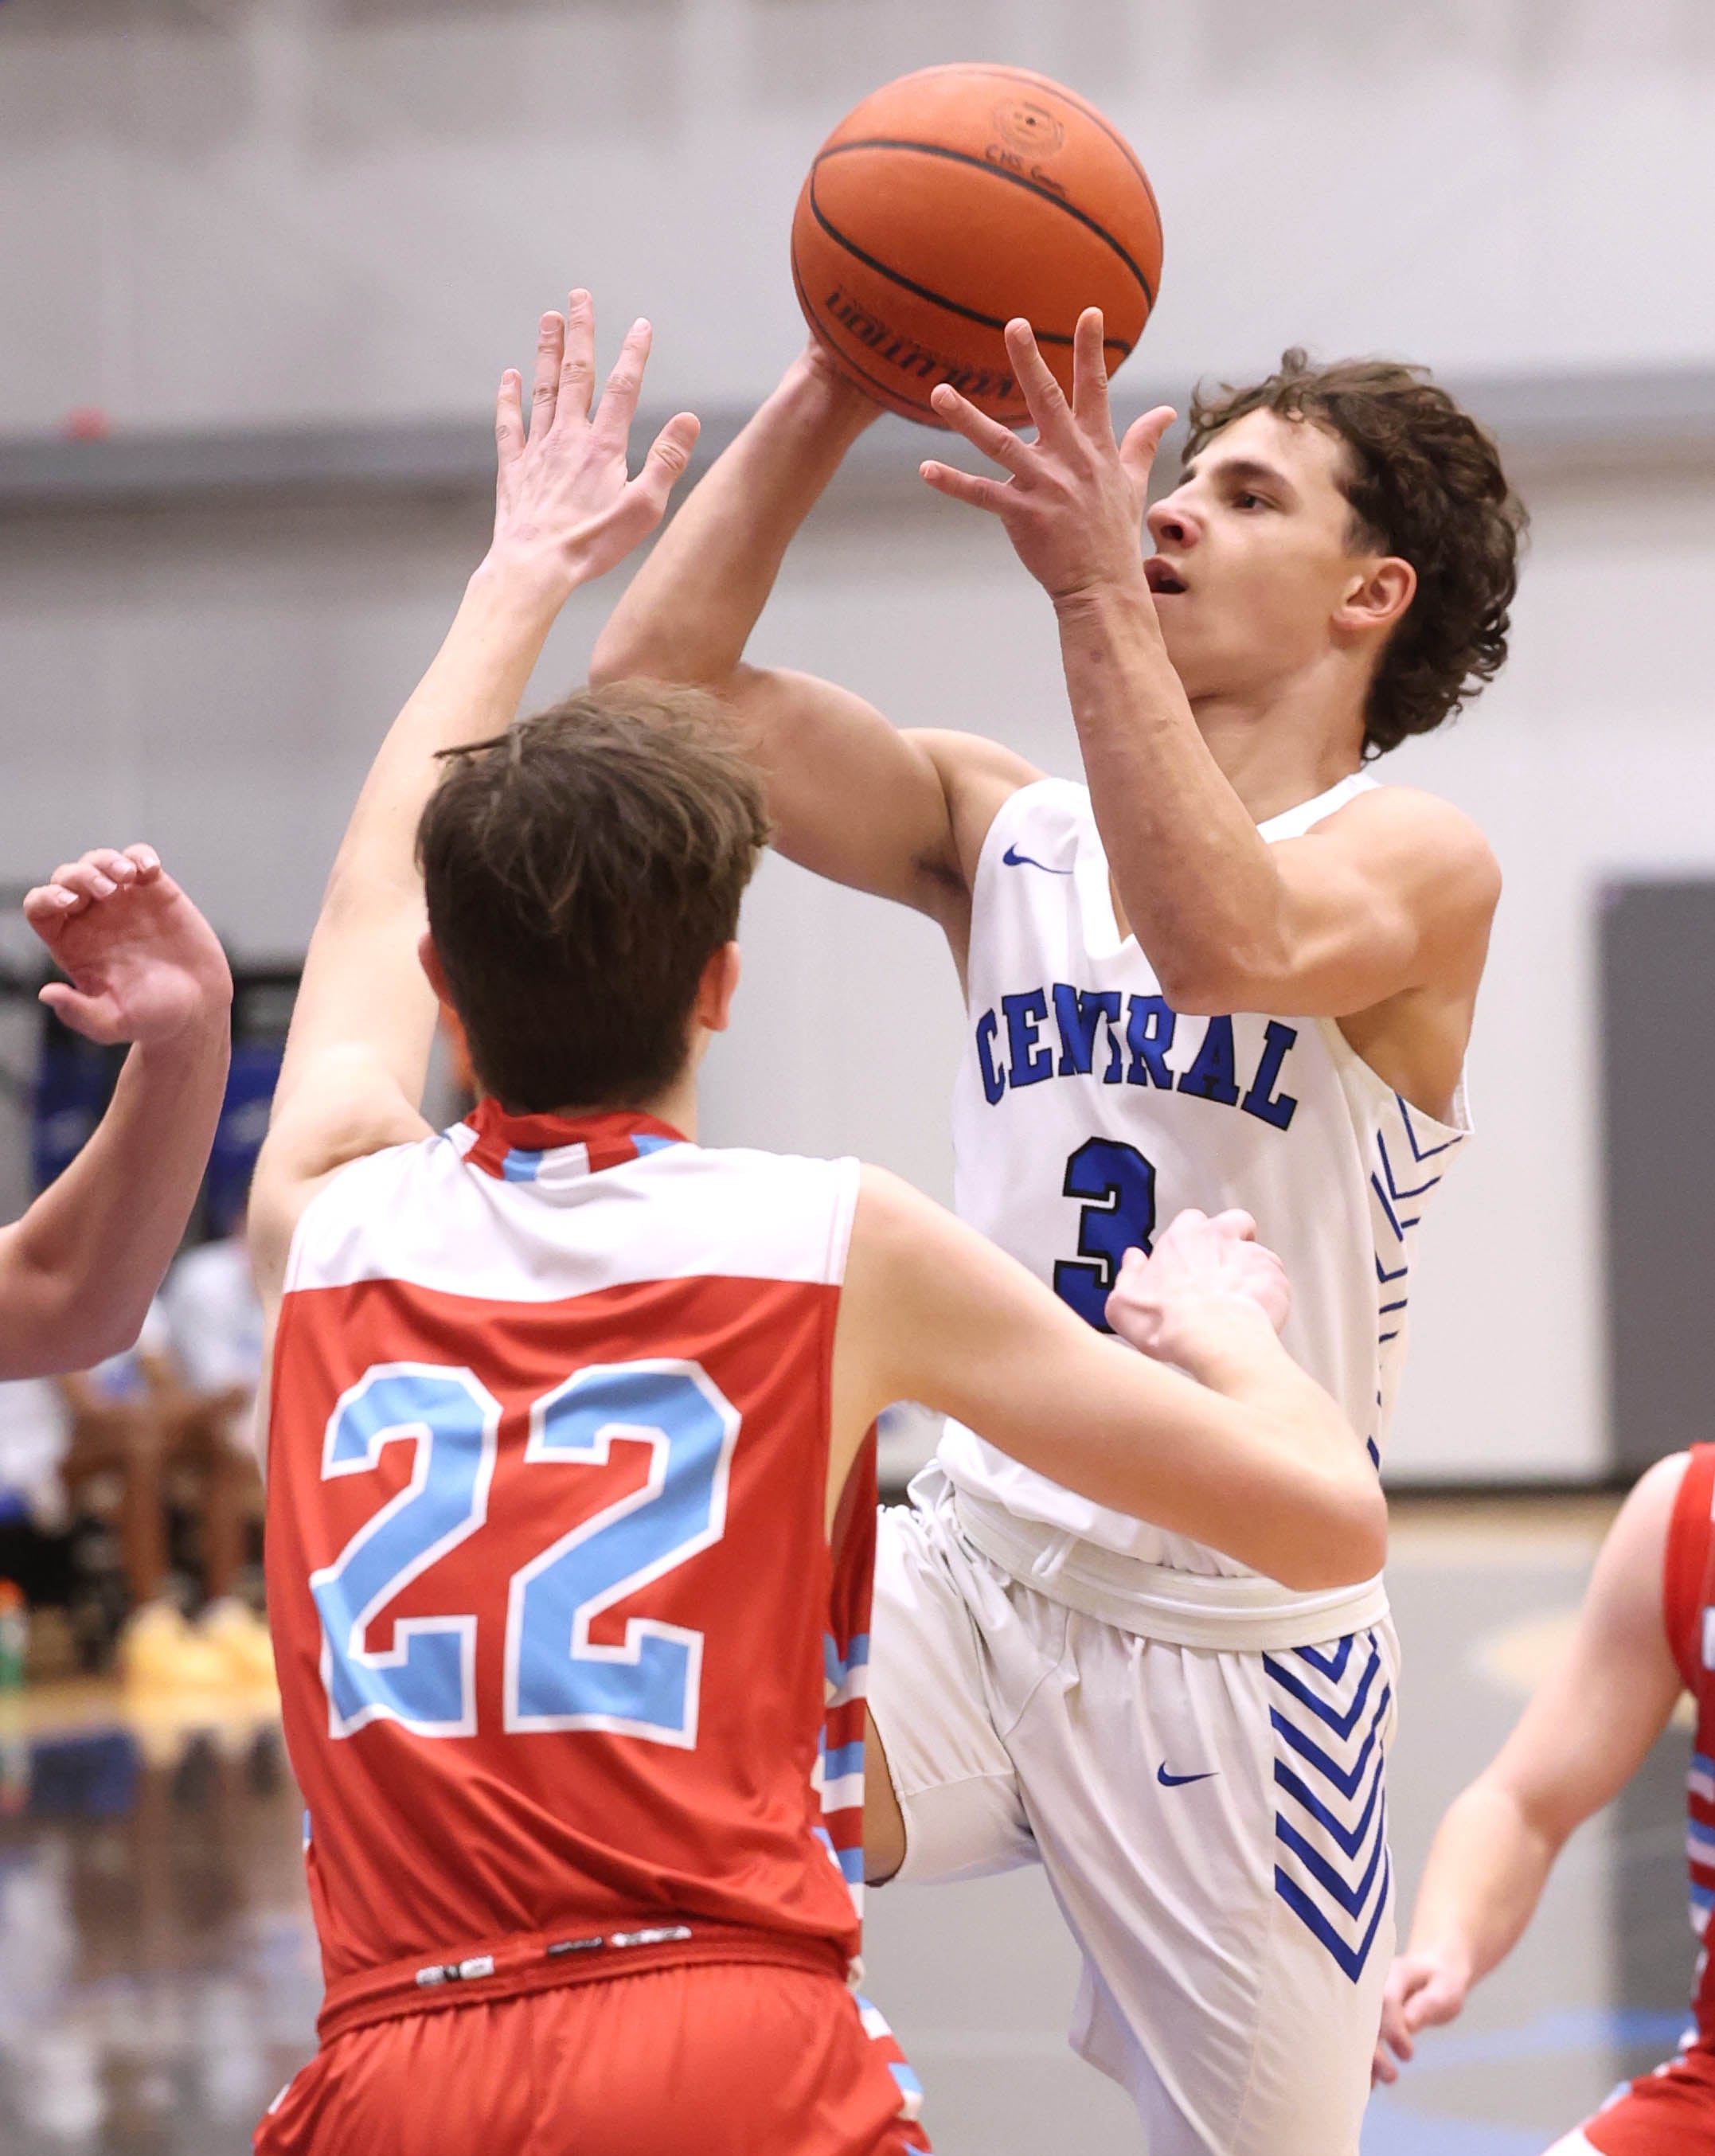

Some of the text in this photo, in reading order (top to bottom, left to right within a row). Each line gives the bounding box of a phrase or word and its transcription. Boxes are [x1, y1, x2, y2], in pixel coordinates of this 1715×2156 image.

[976, 982, 1299, 1131] CENTRAL
[1053, 1136, 1156, 1334] 3
[309, 1359, 742, 1750] 22
